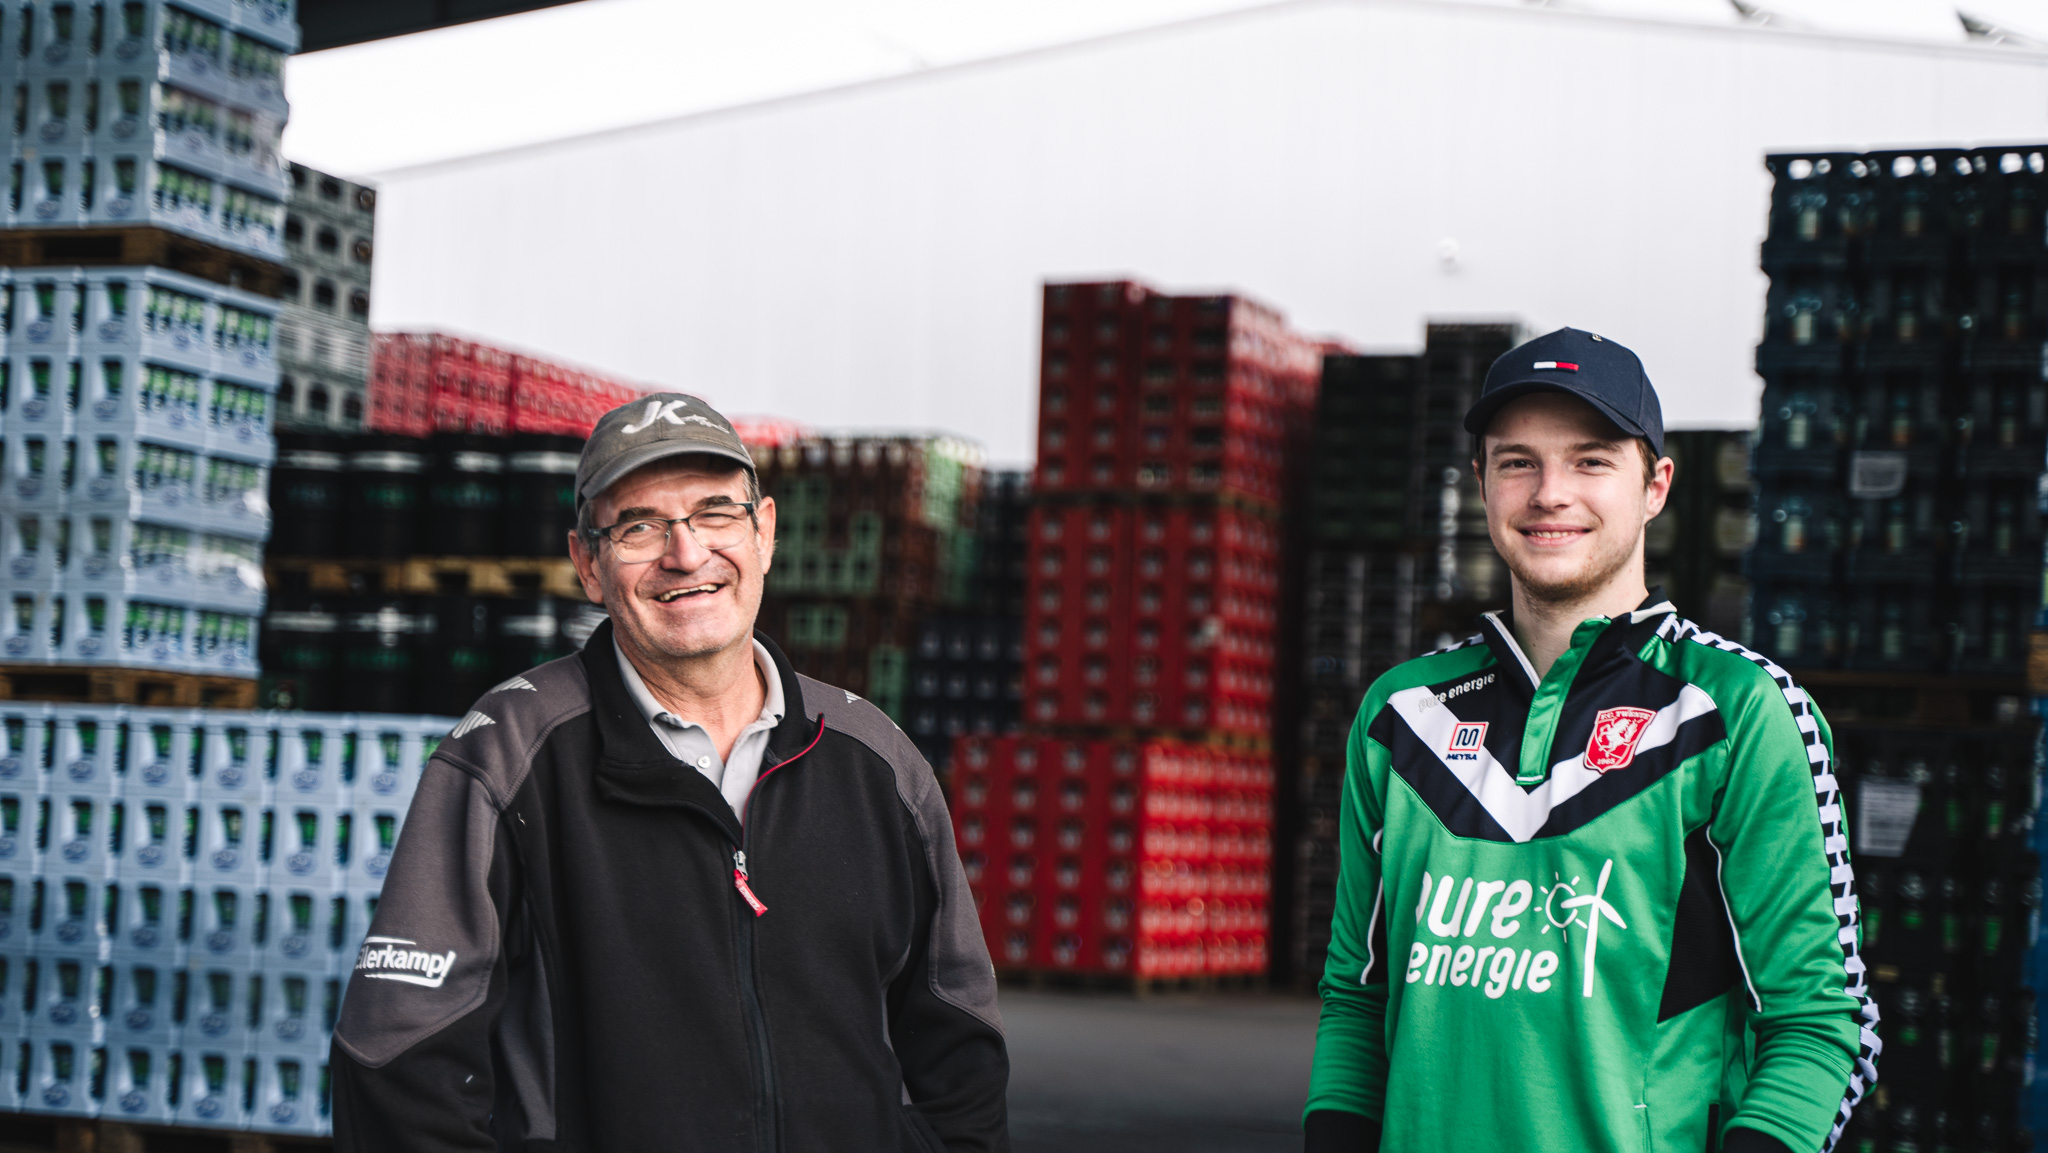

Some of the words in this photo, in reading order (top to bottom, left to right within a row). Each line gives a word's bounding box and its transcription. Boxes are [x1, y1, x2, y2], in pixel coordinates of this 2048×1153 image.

[1417, 692, 1448, 714] pure
[1448, 673, 1495, 699] energie
[1405, 942, 1559, 999] energie
